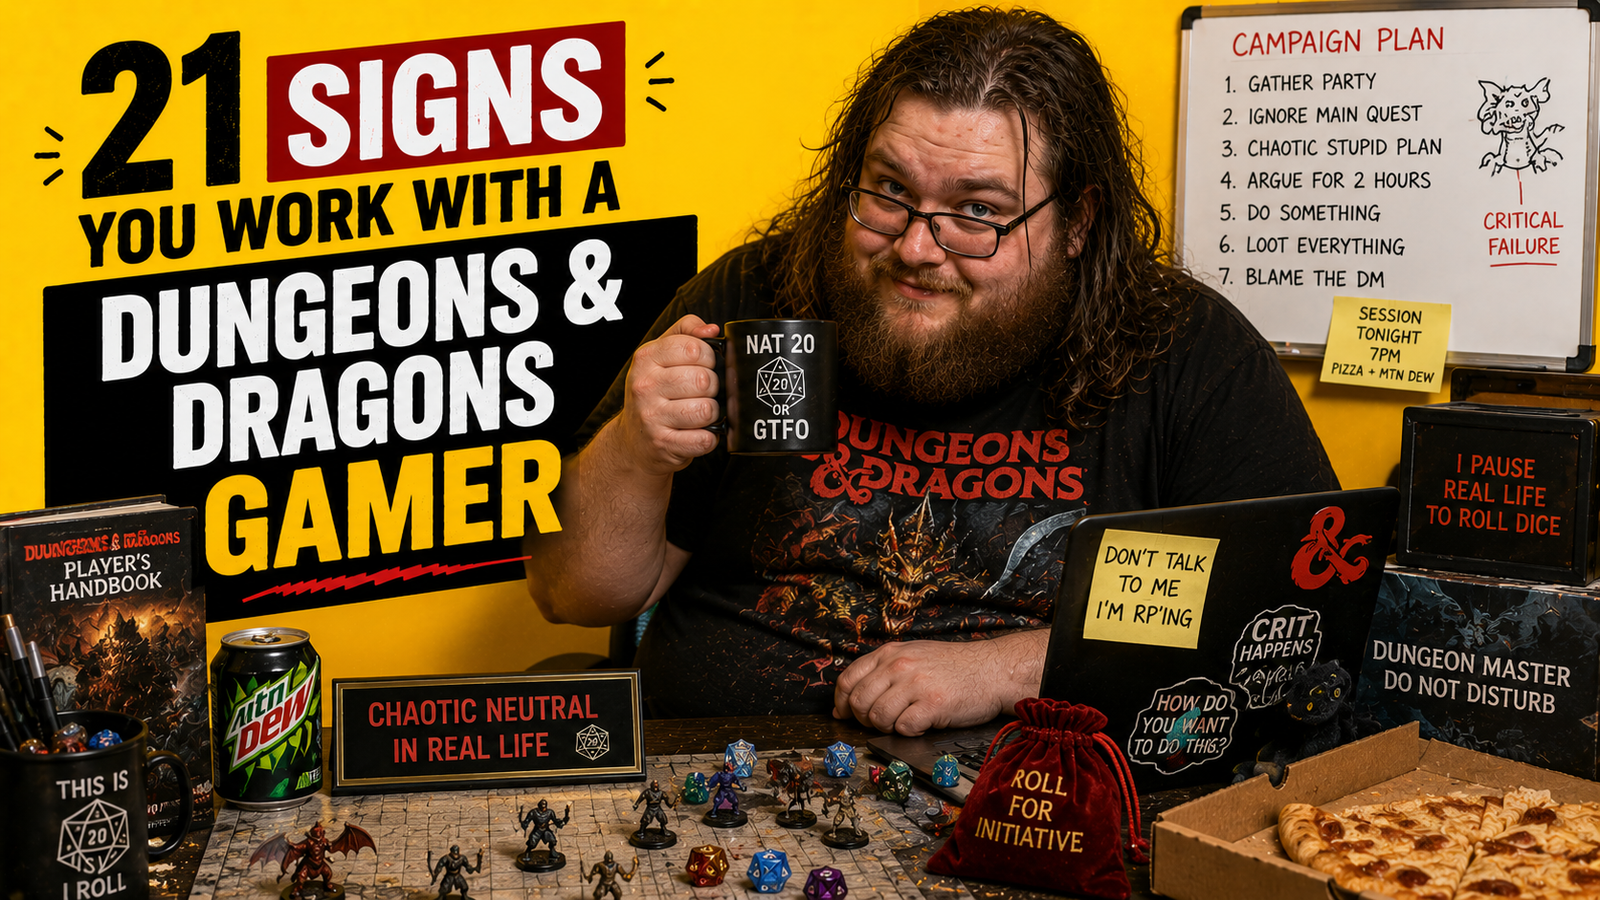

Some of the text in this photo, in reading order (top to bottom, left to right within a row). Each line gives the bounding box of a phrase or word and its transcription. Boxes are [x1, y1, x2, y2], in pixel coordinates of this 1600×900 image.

[1232, 27, 1444, 57] CAMPAIGN PLAN
[1225, 72, 1376, 93] 1. GATHER PARTY
[1222, 105, 1423, 125] 2. IGNORE MAIN QUEST
[1222, 138, 1442, 157] 3. CHAOTIC STUPID PLAN
[1220, 171, 1432, 190] 4. ARGUE FOR 2 HOURS
[1220, 204, 1381, 222] 5. DO SOMETHING
[1484, 211, 1564, 230] CRITICAL
[1219, 235, 1405, 256] 6. LOOT EVERYTHING
[1489, 237, 1560, 256] FAILURE
[1218, 267, 1385, 288] 7. BLAME THE DM
[1358, 306, 1422, 325] SESSION
[746, 334, 815, 354] NAT 20
[1357, 326, 1422, 344] TONIGHT
[1370, 347, 1401, 363] 7PM
[1331, 362, 1363, 376] PIZZA
[1379, 368, 1404, 380] MTN
[1408, 370, 1435, 383] DEW
[772, 378, 788, 391] 20
[772, 404, 790, 416] OR
[753, 419, 810, 440] GTFO
[1457, 453, 1536, 479] I PAUSE
[859, 454, 1085, 500] DRAGONS
[1444, 479, 1547, 507] REAL LIFE
[1426, 504, 1561, 536] TO ROLL DICE
[63, 553, 151, 580] PLAYER'S
[1104, 546, 1207, 573] DON'T TALK
[50, 571, 163, 602] HANDBOOK
[1119, 575, 1181, 597] TO ME
[1096, 600, 1193, 629] I'M RP'ING
[1251, 613, 1315, 642] CRIT
[1239, 638, 1314, 663] HAPPENS
[1373, 639, 1571, 688] DUNGEON MASTER
[1384, 669, 1556, 714] DO NOT DISTURB
[368, 694, 599, 728] CHAOTIC NEUTRAL
[1156, 695, 1229, 712] HOW DO
[1143, 716, 1230, 734] YOU WANT
[393, 732, 549, 763] IN REAL LIFE
[1134, 738, 1153, 756] TO
[1157, 738, 1180, 755] DO
[56, 769, 129, 800] THIS IS
[1010, 769, 1067, 797] ROLL
[1008, 795, 1053, 822] FOR
[87, 827, 107, 846] 20
[975, 817, 1084, 853] INITIATIVE
[63, 873, 127, 900] I ROLL
